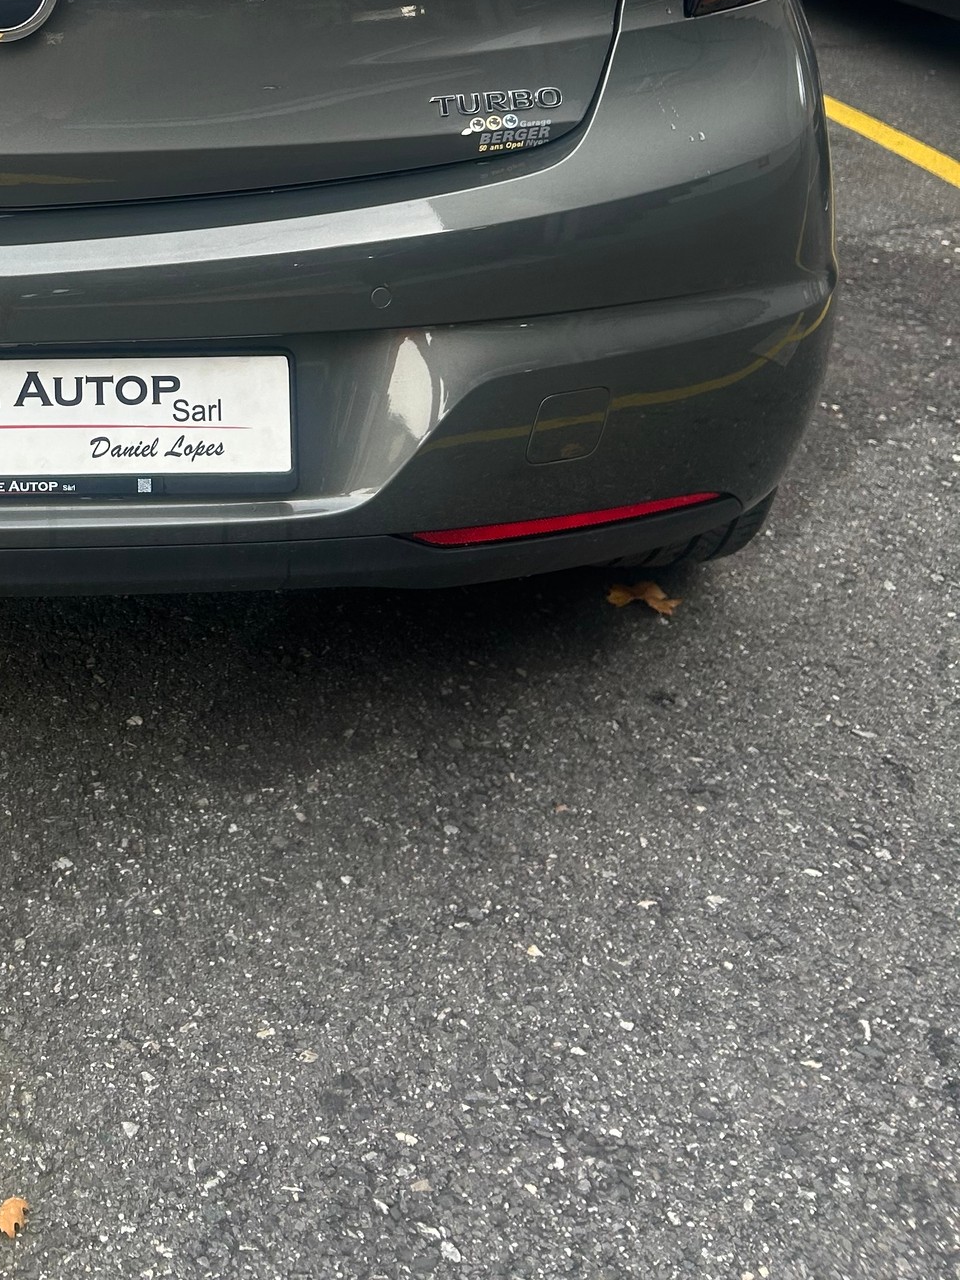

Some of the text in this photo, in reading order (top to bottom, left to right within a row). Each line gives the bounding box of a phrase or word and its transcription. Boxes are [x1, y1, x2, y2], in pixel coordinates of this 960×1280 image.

[429, 87, 563, 117] TURBO
[520, 119, 552, 128] Garage
[480, 126, 551, 145] BERGER
[506, 141, 524, 149] Opel
[13, 371, 181, 408] AUTOP
[171, 399, 223, 423] Sarl
[89, 436, 226, 460] Daniel Lopes
[8, 480, 58, 492] AUTOP
